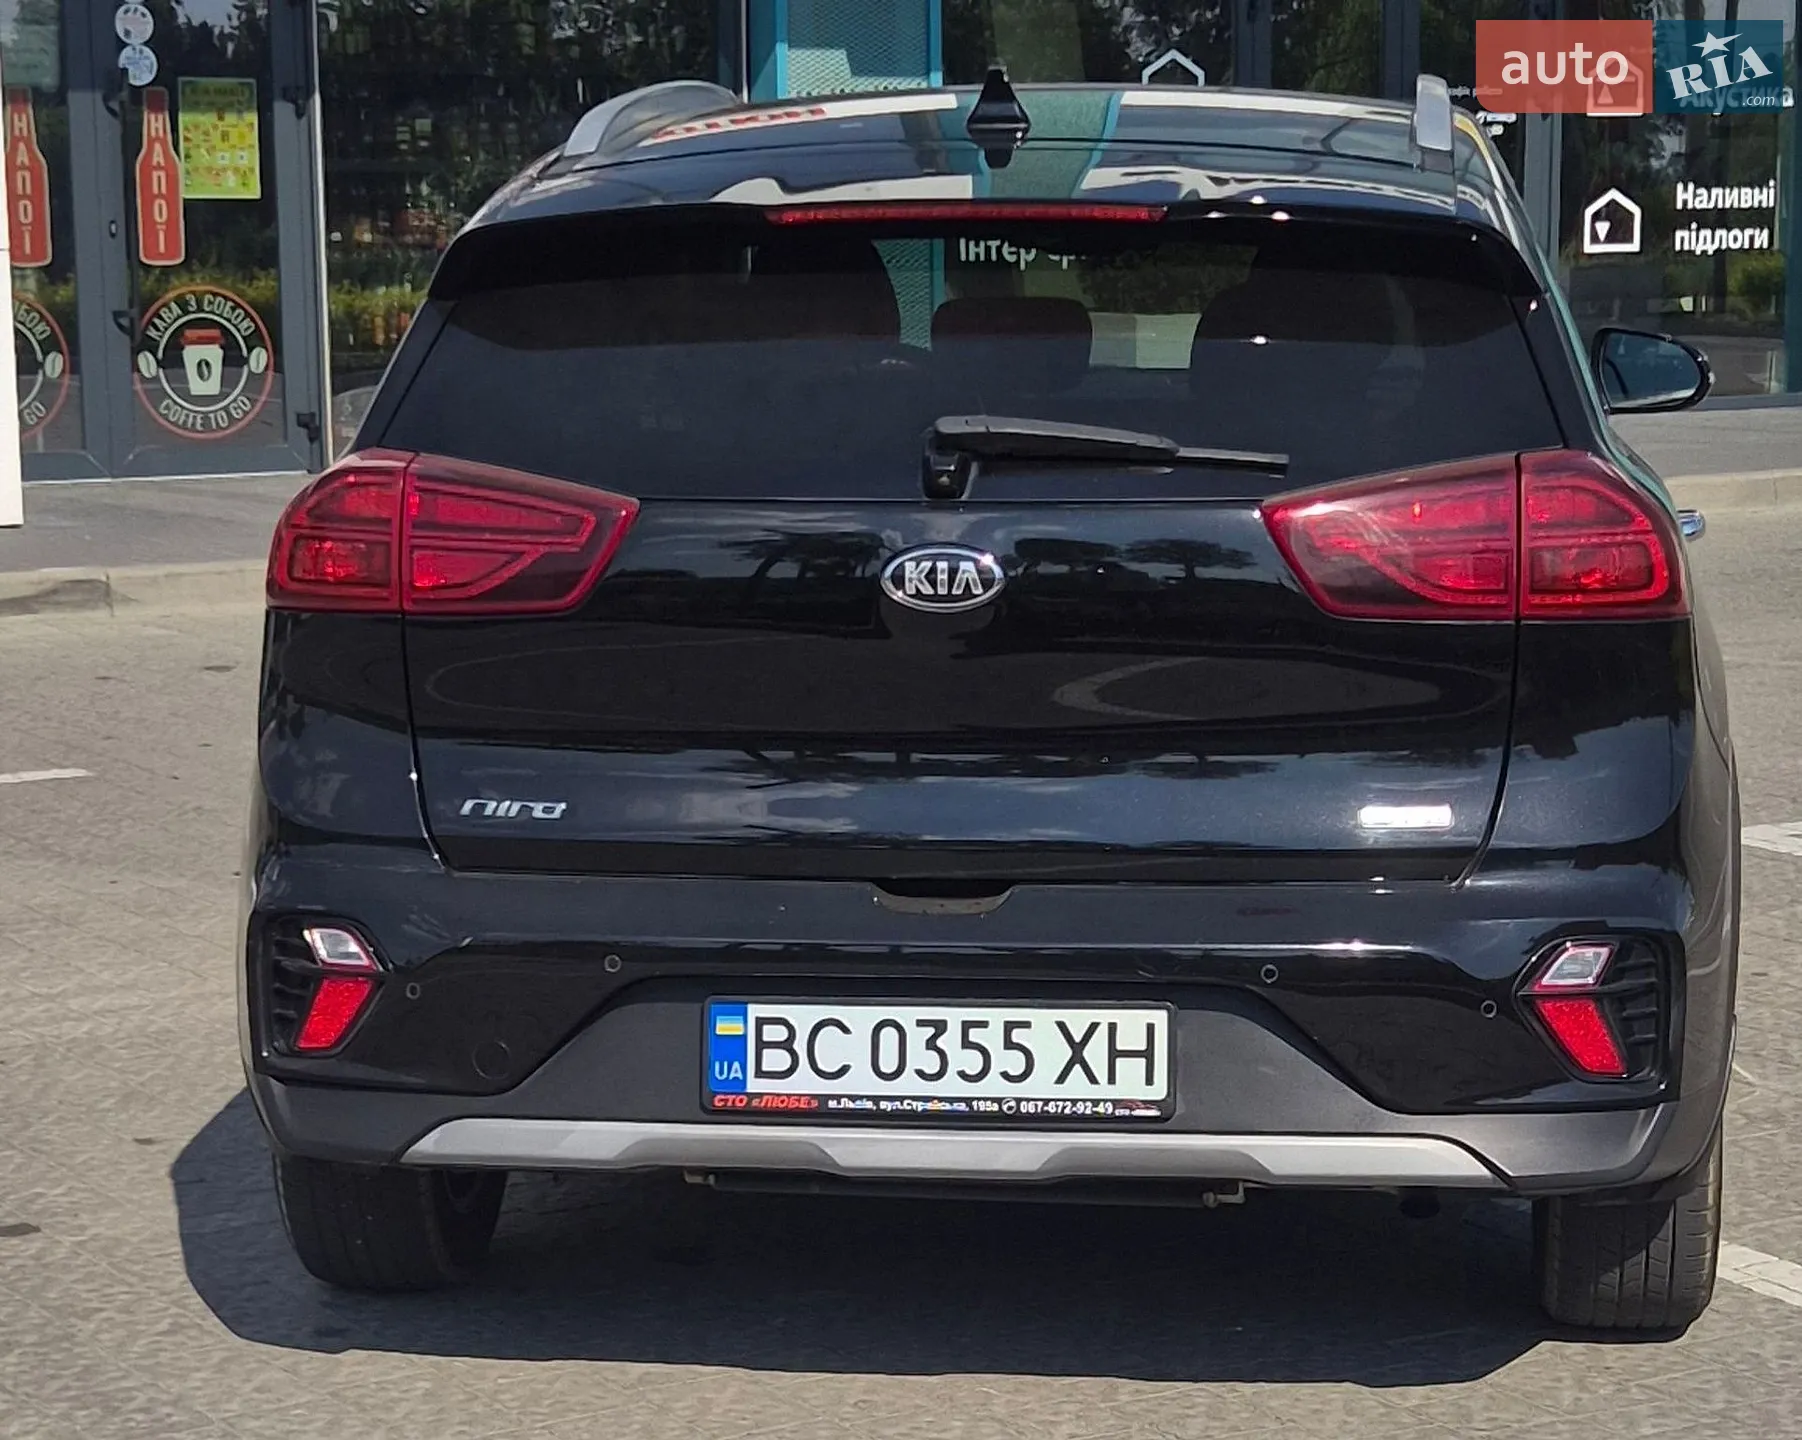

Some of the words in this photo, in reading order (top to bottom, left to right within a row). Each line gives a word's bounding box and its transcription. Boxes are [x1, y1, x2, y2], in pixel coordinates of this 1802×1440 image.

[13, 113, 33, 255] НАПОЇ
[150, 114, 168, 254] НАПОЇ
[1675, 178, 1776, 210] Наливні
[1674, 221, 1770, 256] підлоги
[145, 301, 184, 341] КАВА
[203, 294, 256, 337] СОБОЮ
[23, 400, 46, 425] GO
[208, 410, 230, 429] TO
[229, 396, 252, 419] GO
[904, 560, 984, 595] KIA
[754, 1016, 853, 1081] BC
[870, 1018, 1035, 1084] 0355
[1053, 1020, 1156, 1086] XH
[714, 1061, 743, 1080] UA
[713, 1094, 748, 1108] СТО
